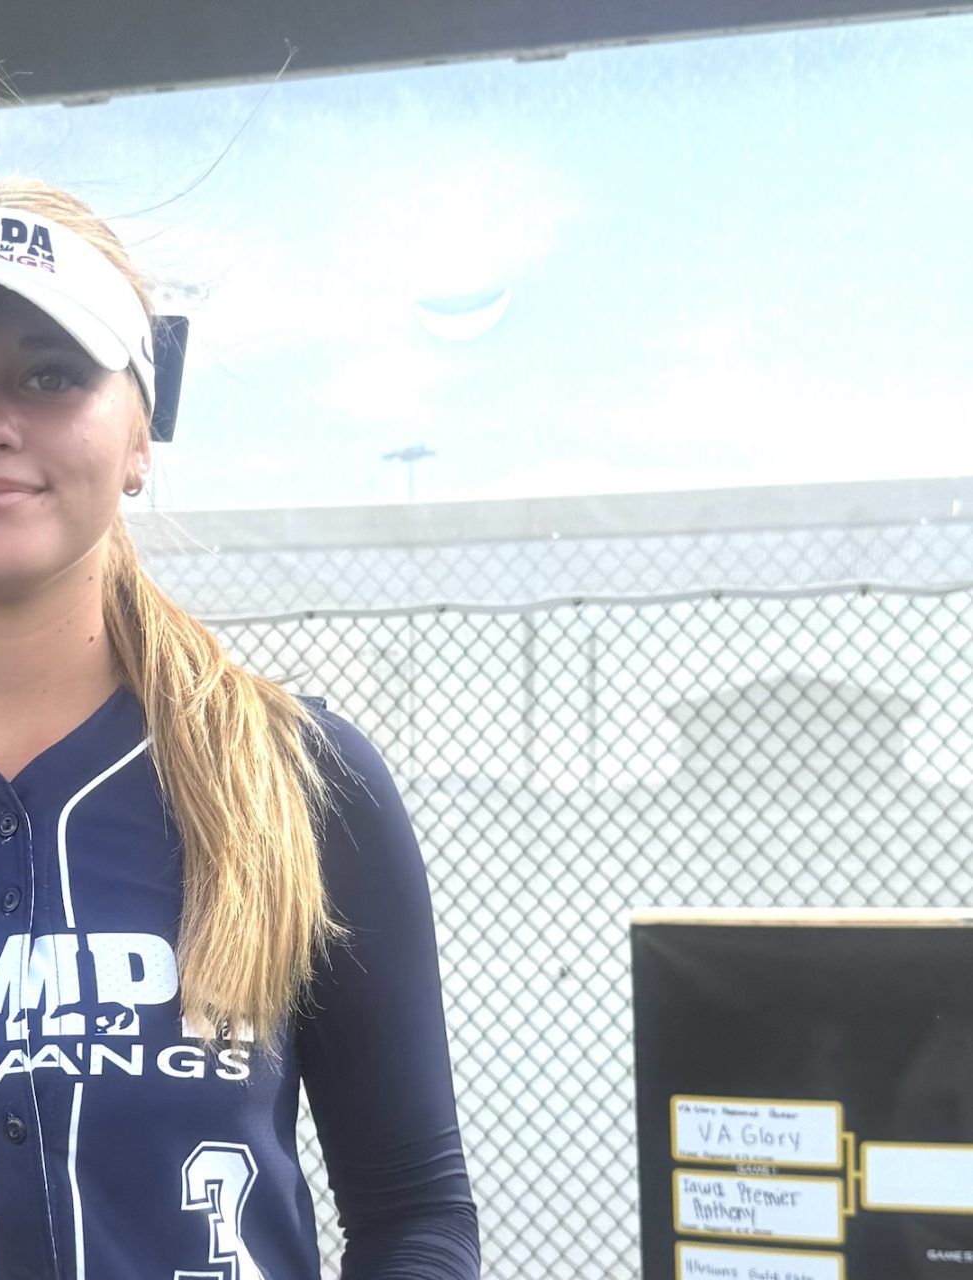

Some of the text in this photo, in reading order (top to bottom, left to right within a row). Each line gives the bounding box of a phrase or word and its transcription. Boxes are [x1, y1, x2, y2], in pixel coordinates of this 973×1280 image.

[741, 1122, 801, 1151] Glory
[737, 1181, 801, 1206] Premier
[693, 1197, 756, 1226] Anthony
